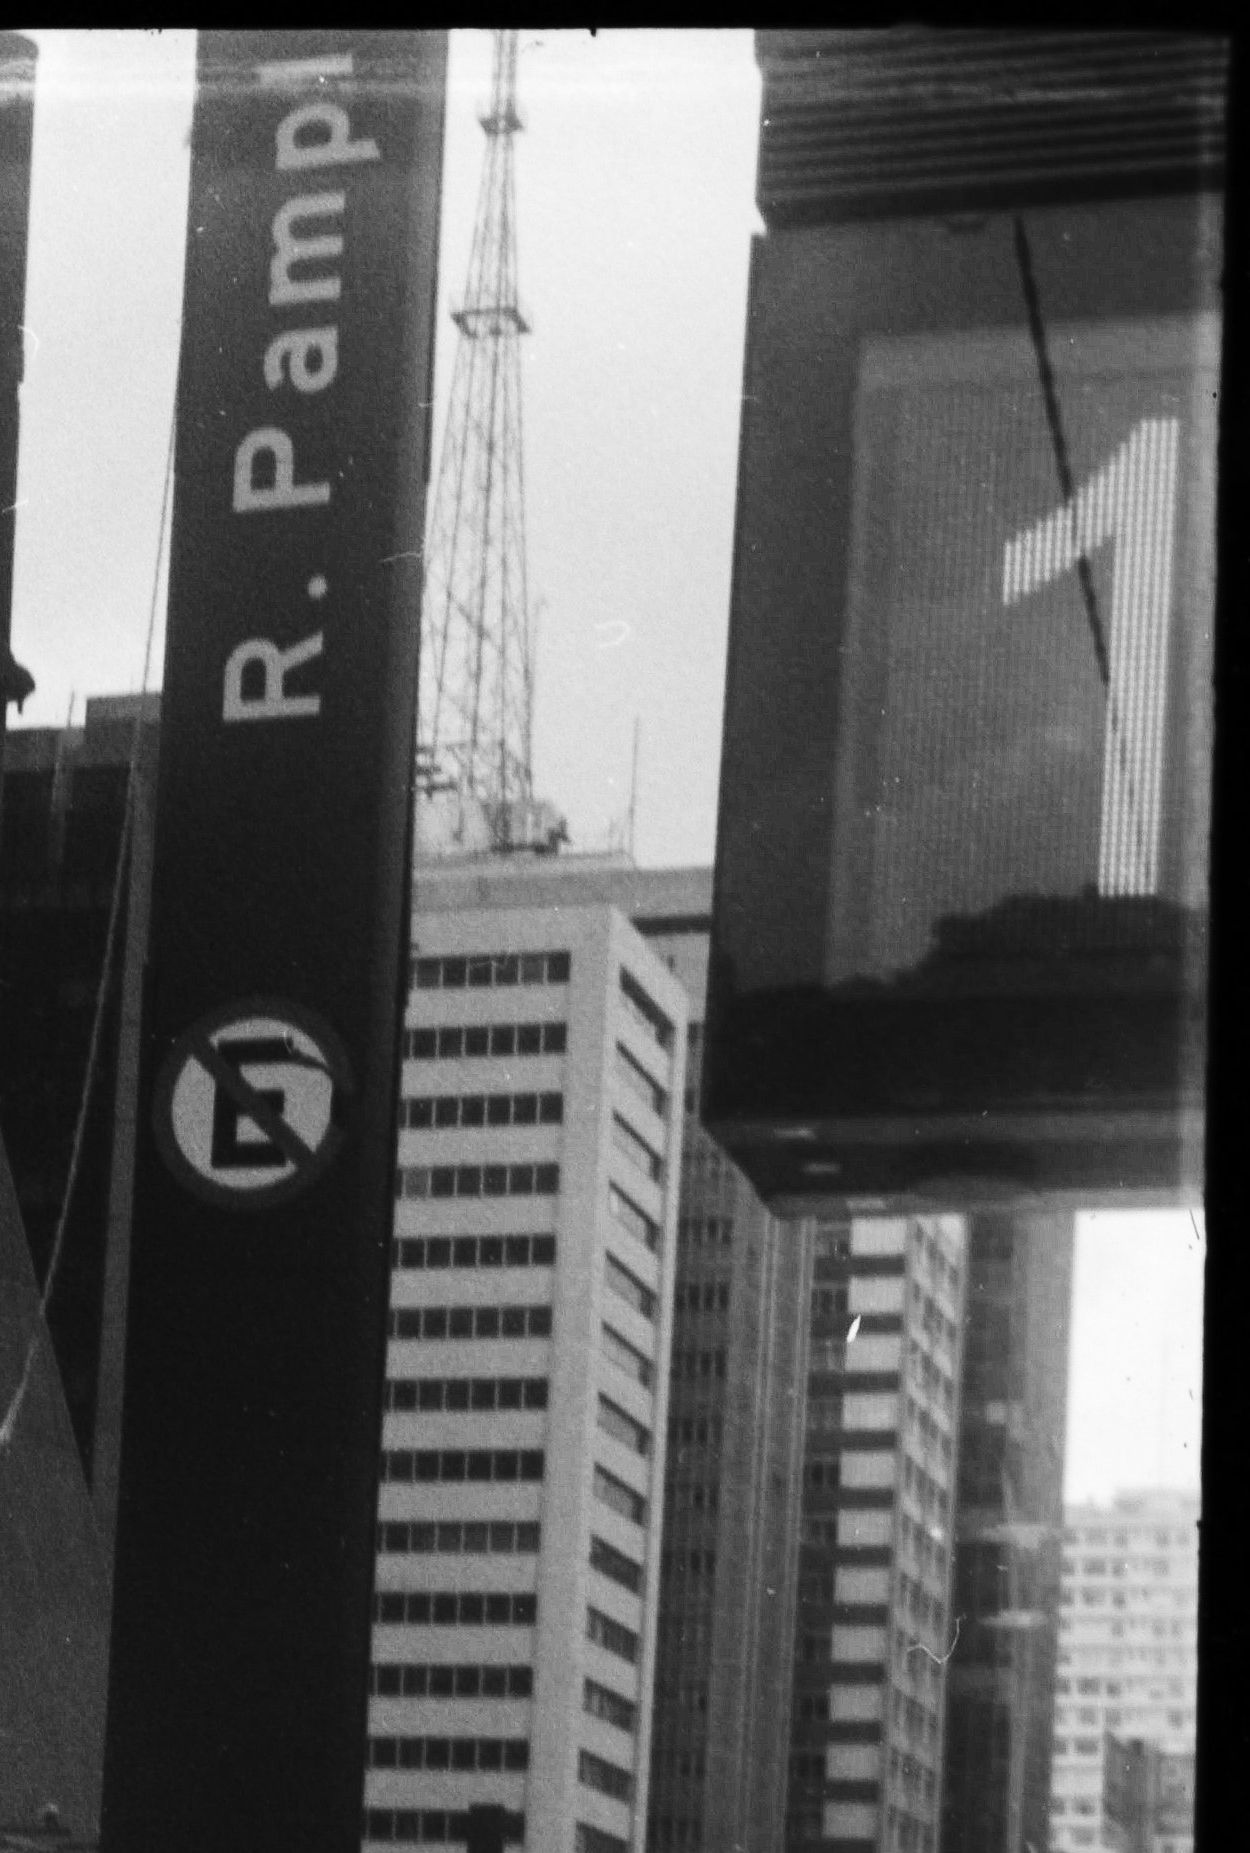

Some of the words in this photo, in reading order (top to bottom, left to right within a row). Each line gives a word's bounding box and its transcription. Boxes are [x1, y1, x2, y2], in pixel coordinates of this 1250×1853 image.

[232, 54, 381, 513] Pampl
[222, 575, 327, 722] R.
[1001, 417, 1180, 896] 1
